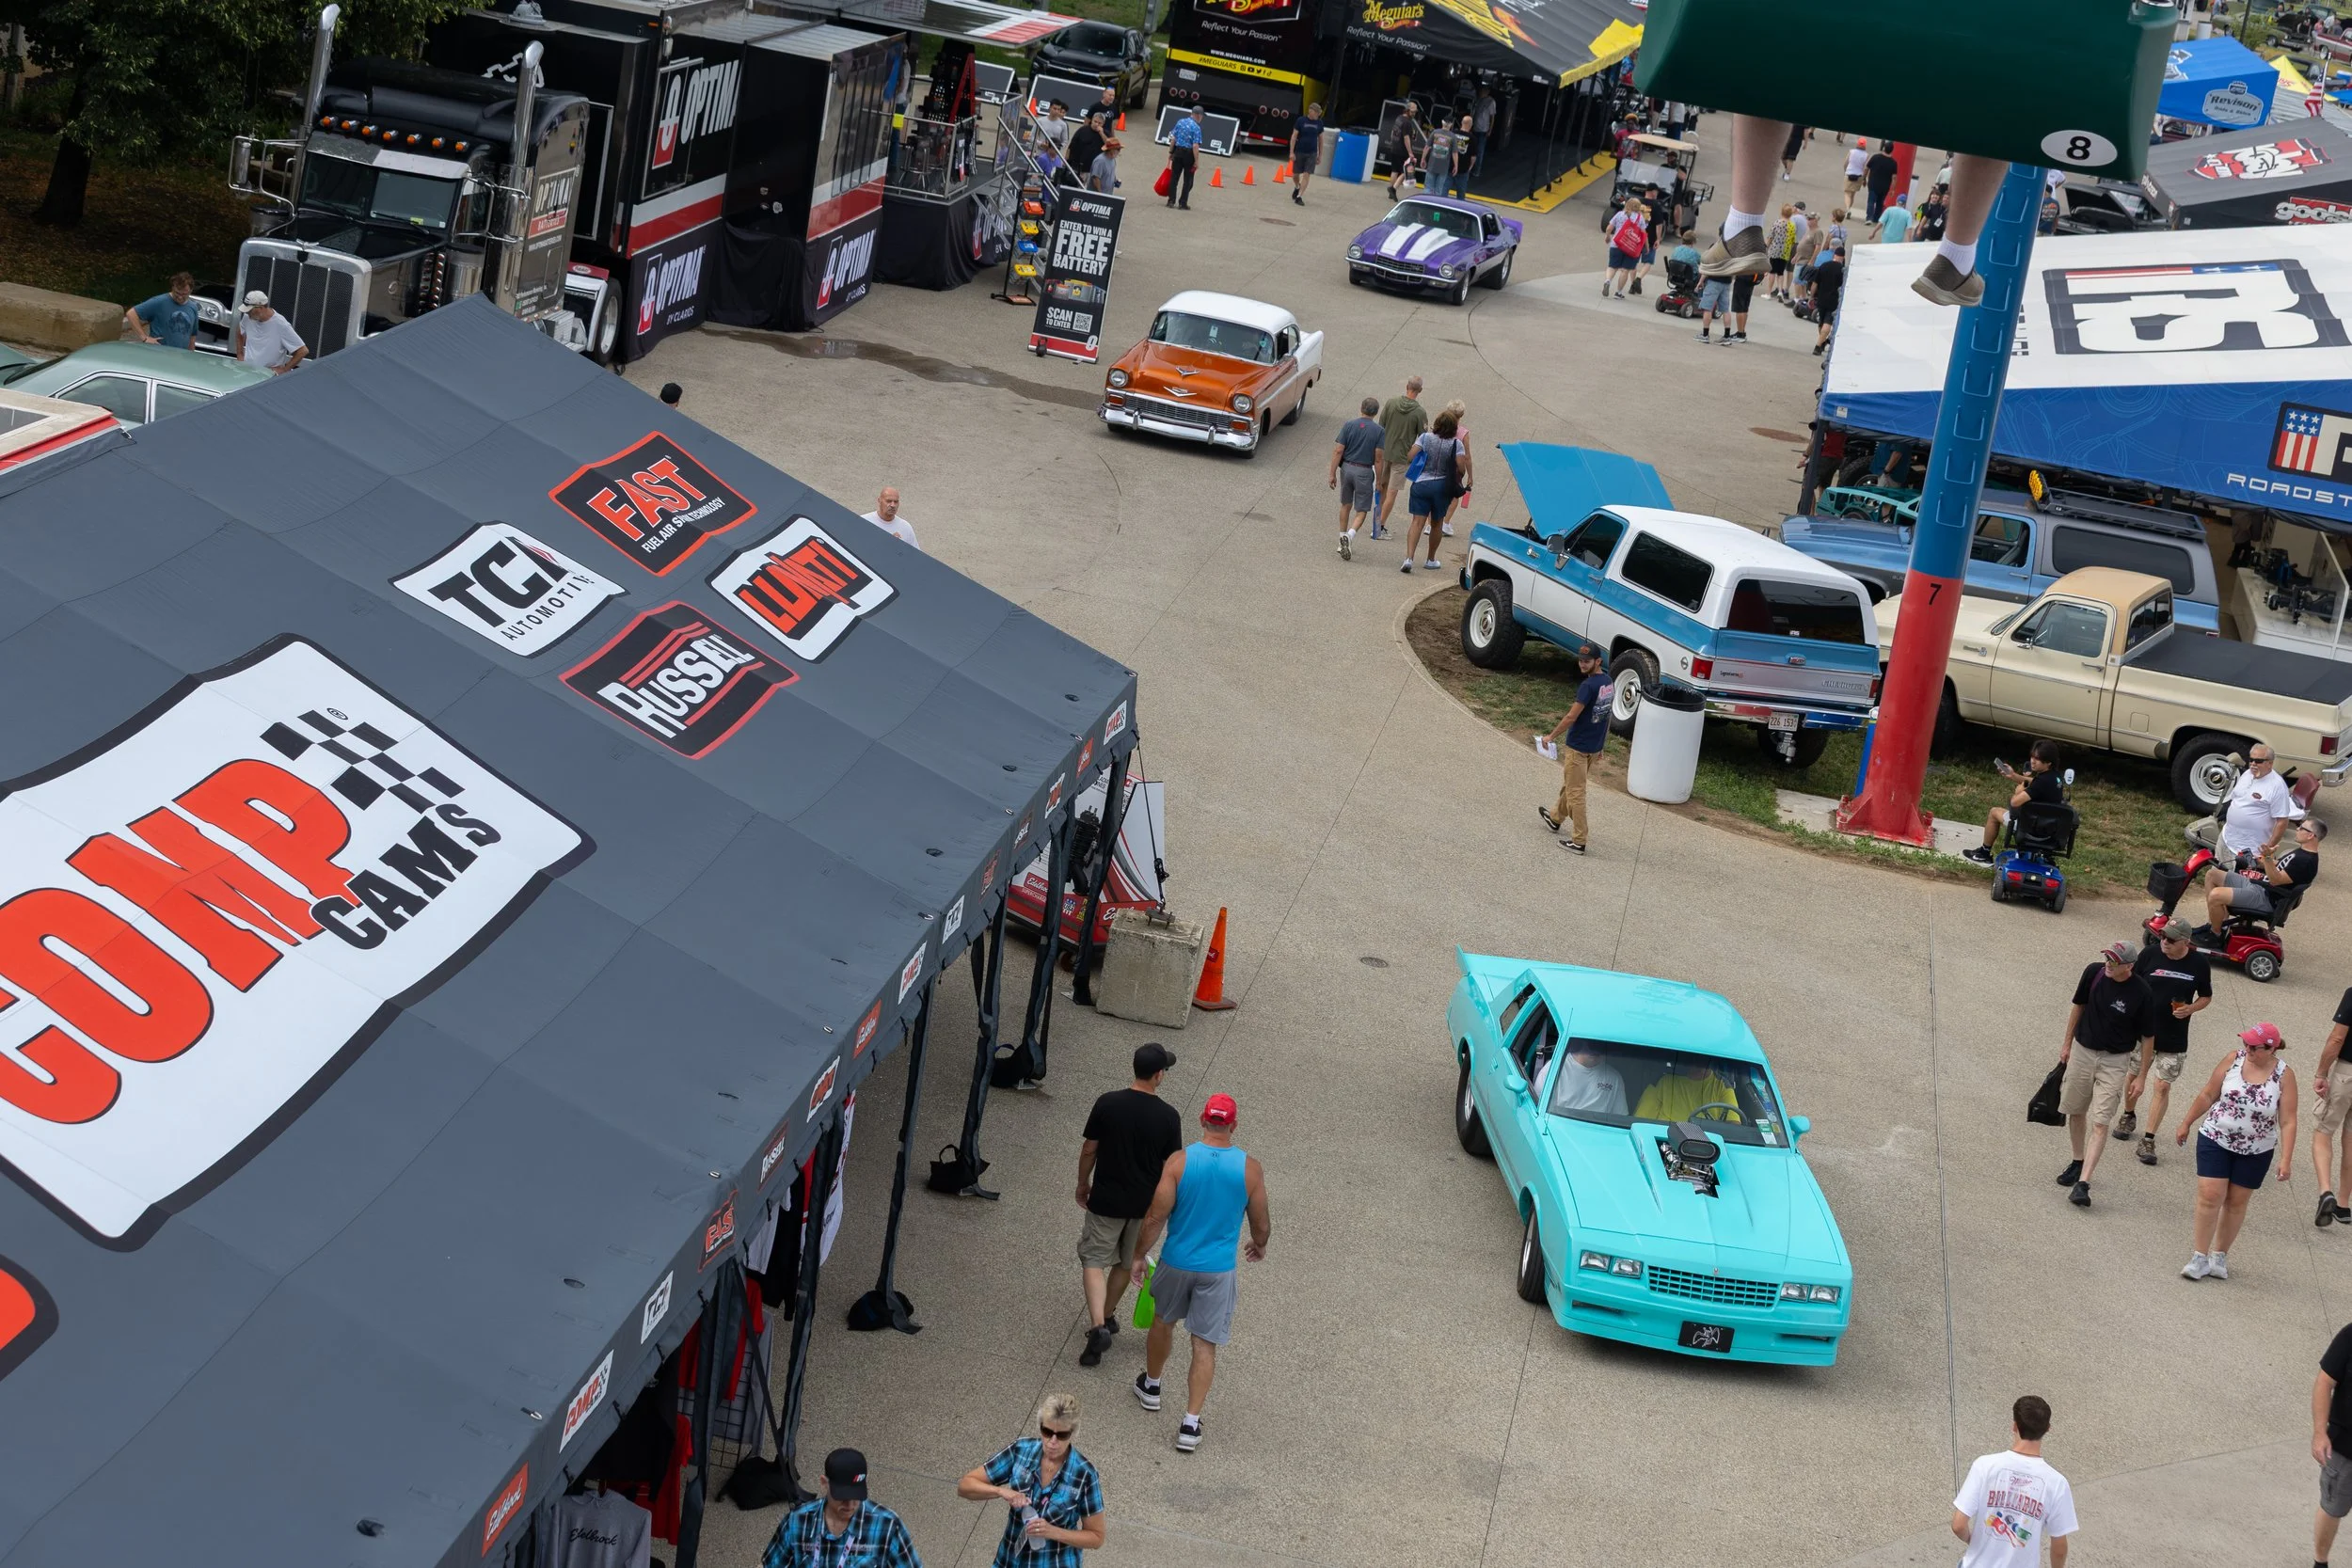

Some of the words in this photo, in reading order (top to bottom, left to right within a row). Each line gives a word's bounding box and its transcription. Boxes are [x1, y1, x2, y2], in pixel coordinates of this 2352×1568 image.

[1201, 20, 1229, 33] Reflect
[1231, 26, 1248, 37] Your
[1248, 30, 1279, 42] Passion
[1346, 25, 1375, 39] Reflect
[1377, 32, 1394, 43] Your
[1395, 37, 1427, 51] Passion
[1199, 56, 1237, 71] #MEGUIARS
[2211, 96, 2258, 111] Revison
[2066, 135, 2091, 161] 8
[534, 177, 569, 214] OPTIMA
[1081, 201, 1112, 216] OPTIMA
[1059, 220, 1082, 233] ENTER
[1083, 224, 1091, 233] TO
[1092, 226, 1106, 237] WIN
[1106, 230, 1113, 238] A
[1055, 229, 1112, 262] FREE
[834, 230, 876, 292] OPTIMA
[1052, 253, 1107, 277] BATTERY
[656, 245, 703, 314] OPTIMA
[1046, 317, 1053, 326] TO
[1053, 319, 1072, 329] ENTER
[1047, 307, 1073, 322] SCAN
[587, 457, 707, 542] FAST
[642, 535, 664, 553] FUEL
[659, 523, 677, 541] AIR
[689, 497, 726, 520] TECHNOLOGY
[1929, 583, 1942, 606] 7
[311, 804, 501, 950] CAMS
[564, 1375, 600, 1437] COMP
[1987, 1490, 2044, 1521] BILLIARDS
